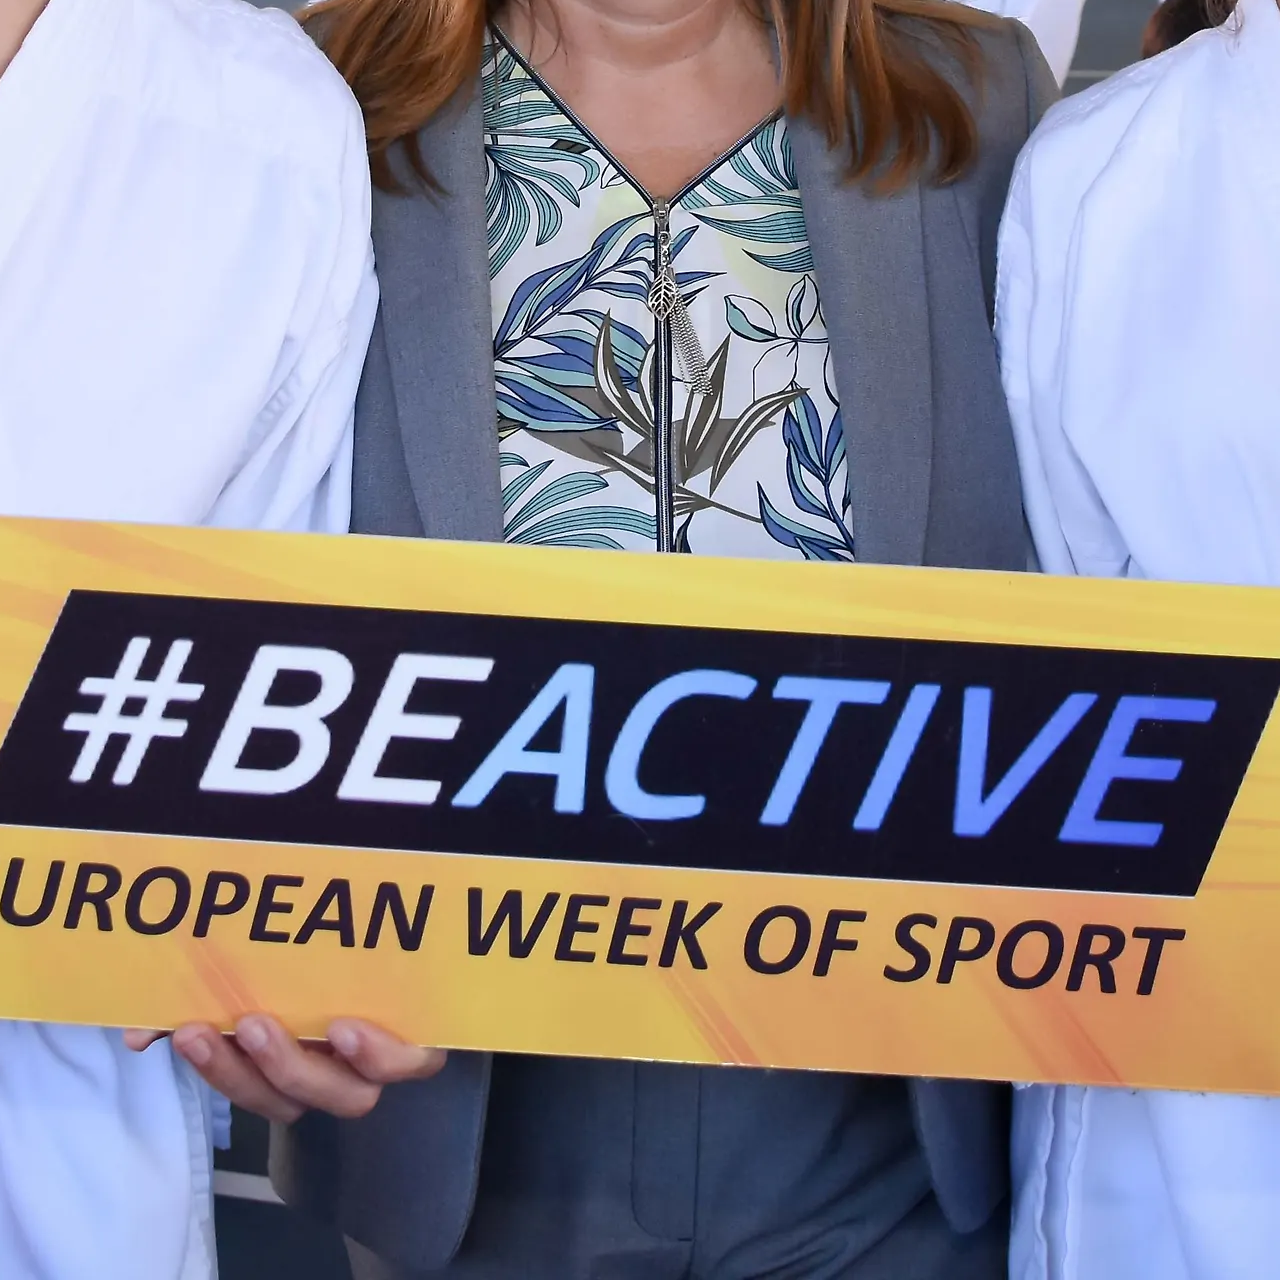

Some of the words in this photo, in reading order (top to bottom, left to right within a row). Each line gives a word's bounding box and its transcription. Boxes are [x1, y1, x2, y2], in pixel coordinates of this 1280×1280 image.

[61, 635, 1219, 848] #BEACTIVE
[466, 887, 723, 971] WEEK
[742, 905, 868, 978] OF
[882, 912, 1187, 997] SPORT
